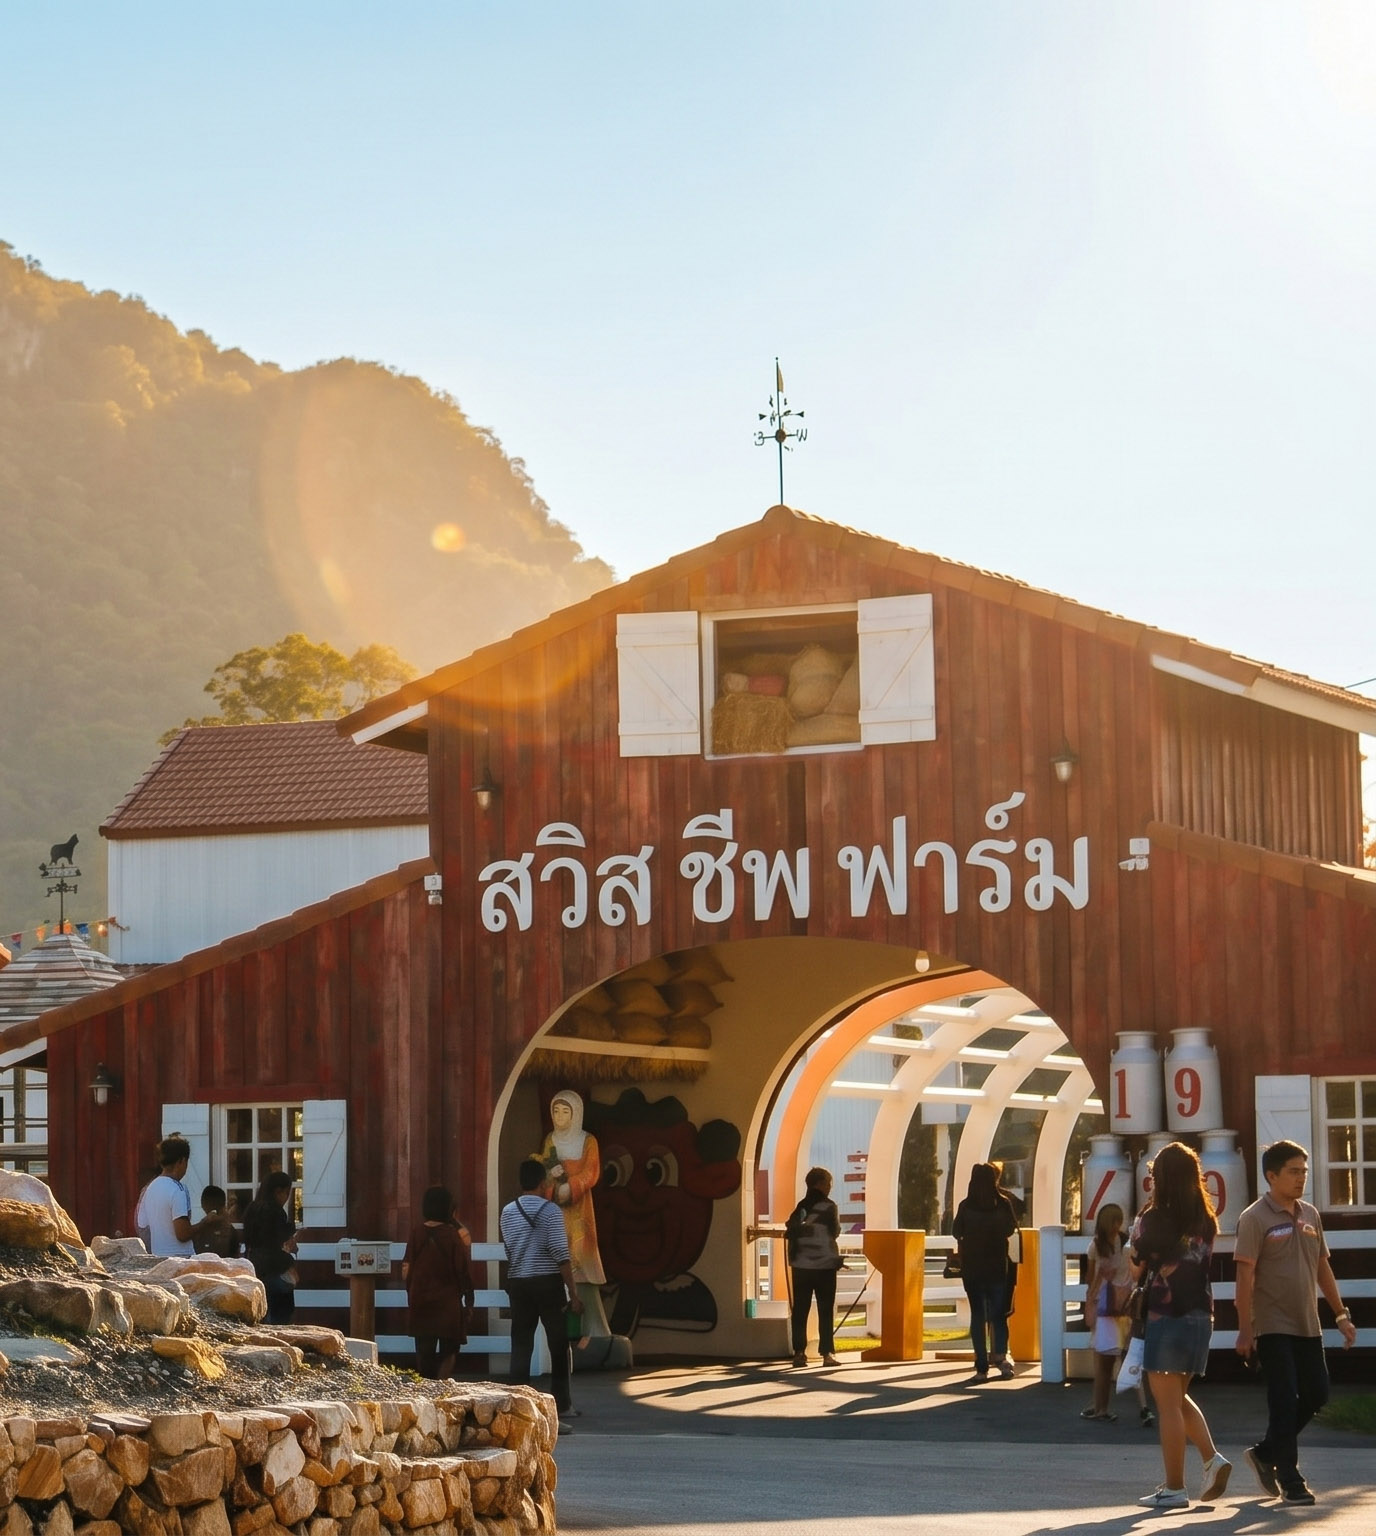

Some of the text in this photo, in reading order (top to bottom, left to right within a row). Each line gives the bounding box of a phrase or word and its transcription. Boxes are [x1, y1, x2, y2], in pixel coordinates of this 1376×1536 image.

[478, 792, 1089, 932] สวิส ชีพ ฟาร์ม
